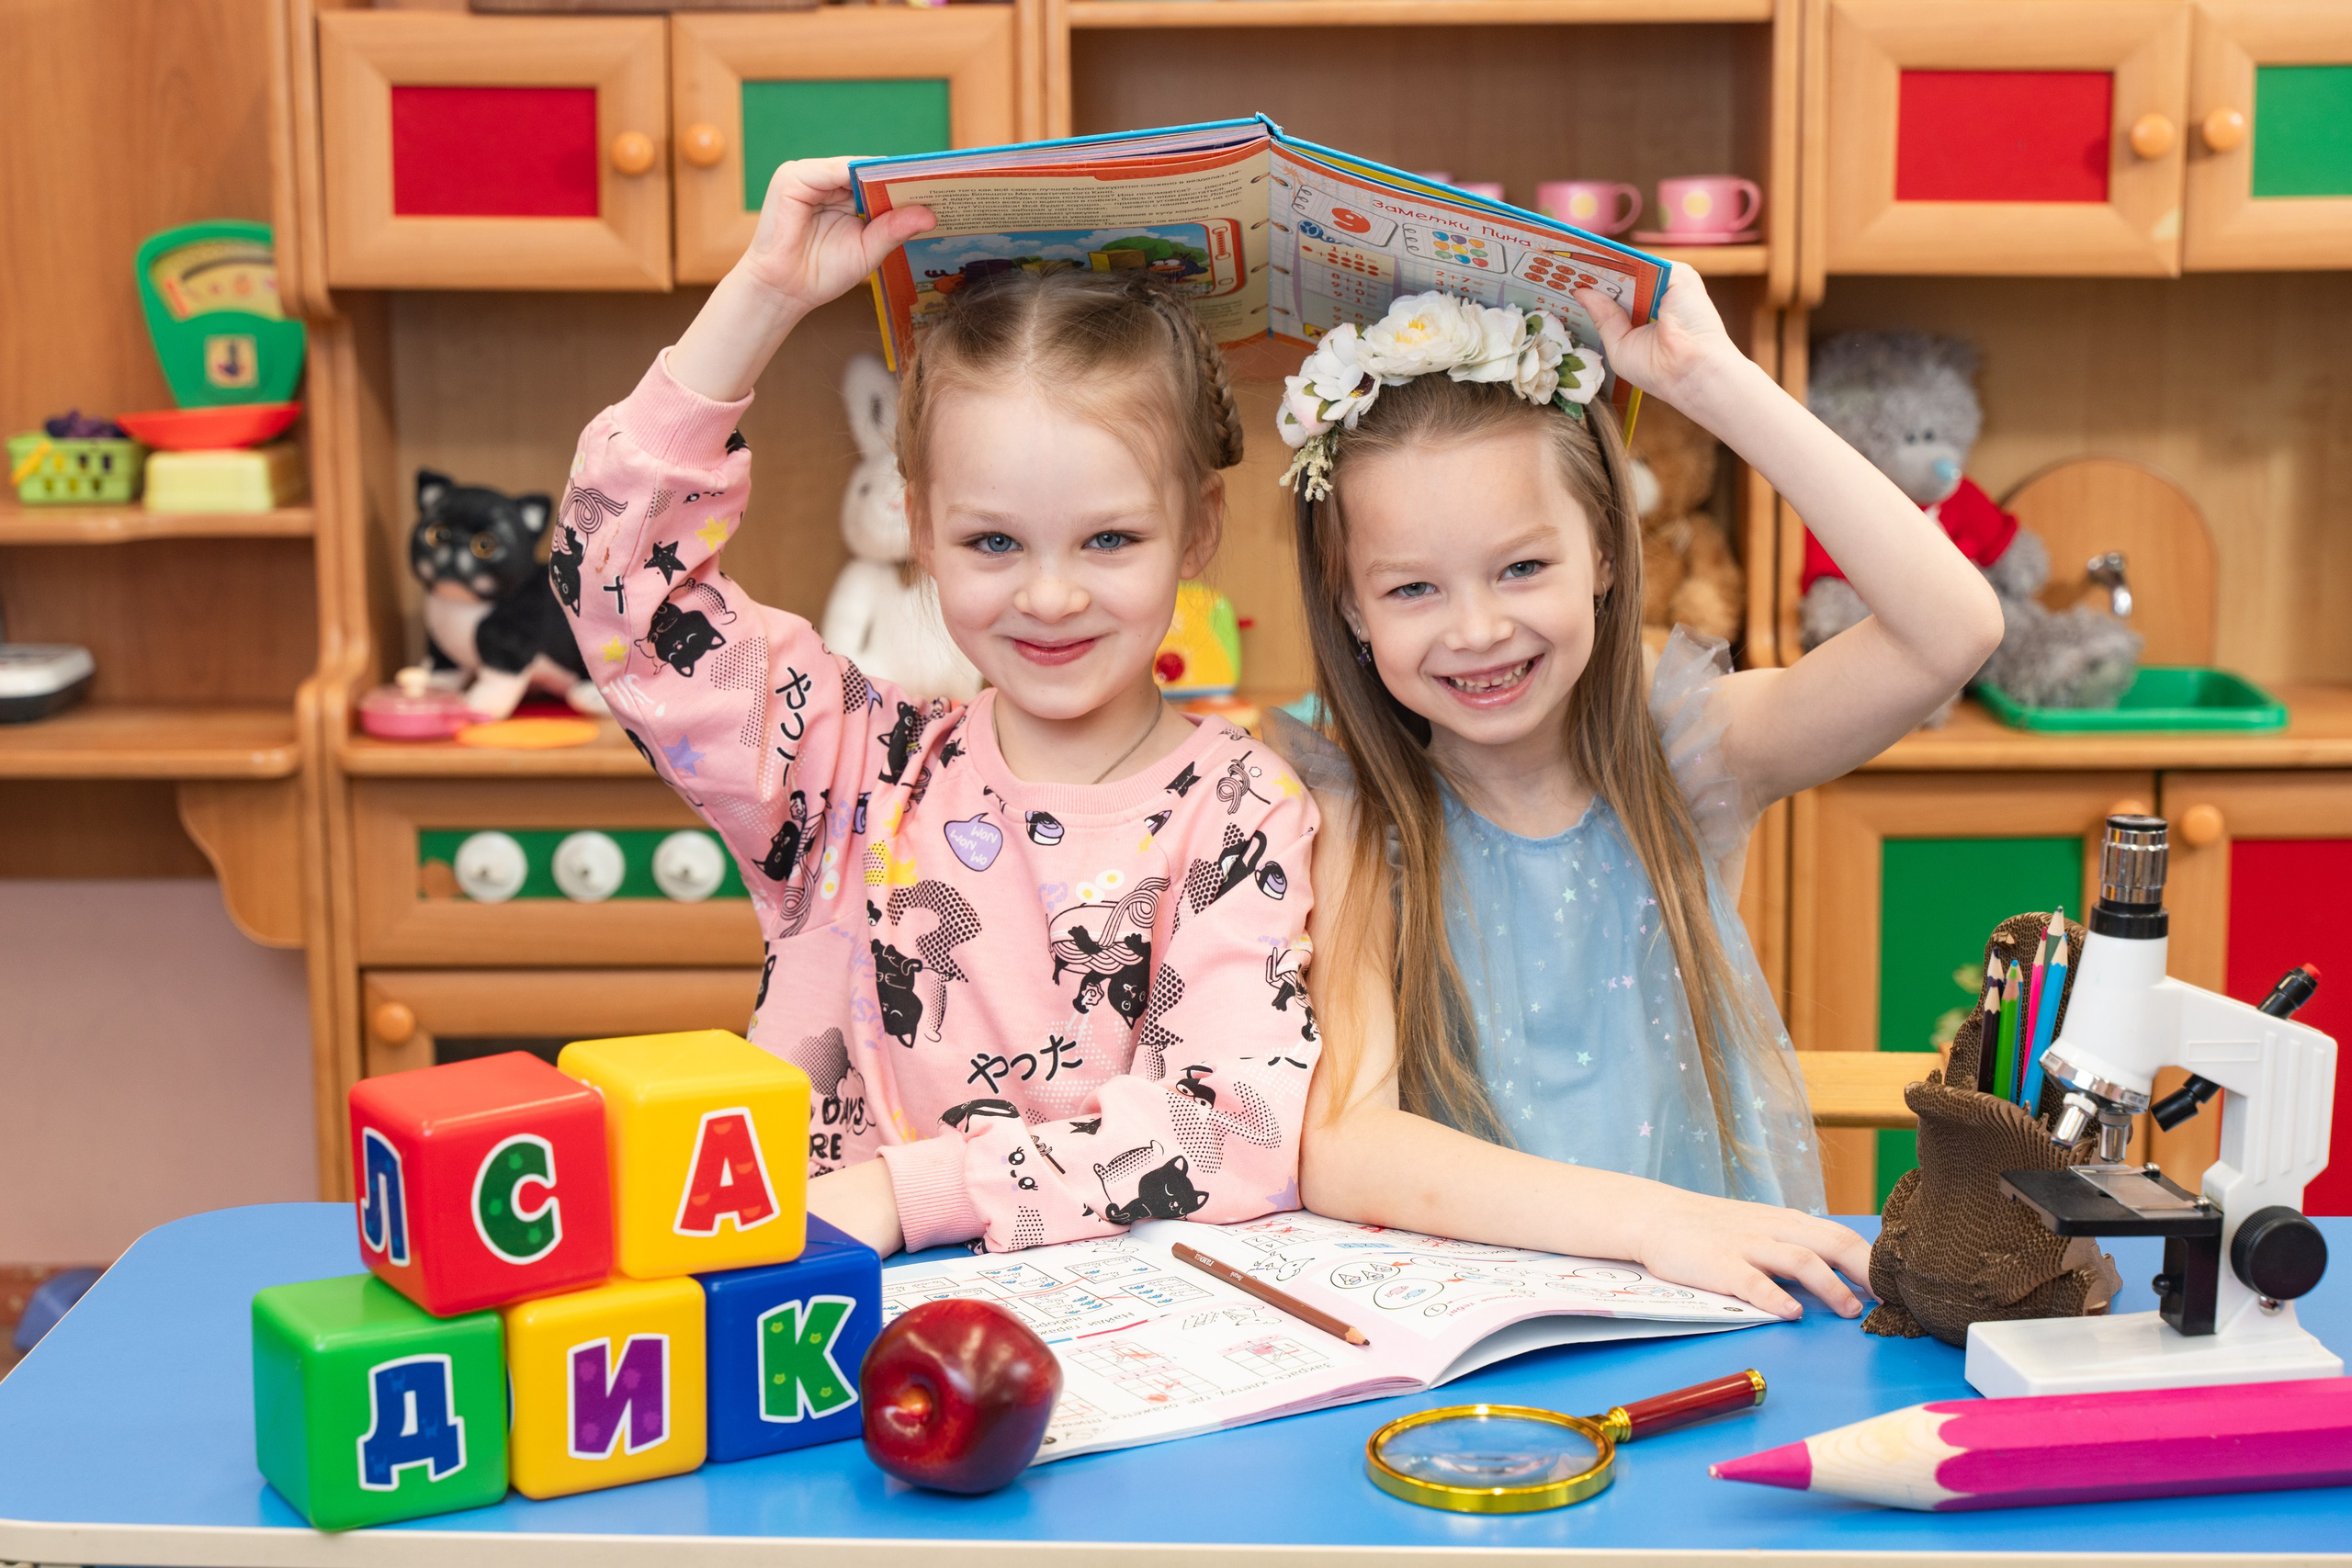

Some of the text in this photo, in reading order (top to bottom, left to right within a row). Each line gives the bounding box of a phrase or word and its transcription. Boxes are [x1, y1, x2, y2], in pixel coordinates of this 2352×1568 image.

[1331, 208, 1371, 233] 9
[1373, 199, 1532, 247] Заметки Пина
[949, 829, 978, 851] NOM
[970, 825, 999, 843] NOM
[970, 851, 988, 865] OM
[967, 1033, 1084, 1095] やった
[809, 1133, 842, 1160] RE
[673, 1106, 780, 1237] А
[361, 1126, 410, 1267] Л
[470, 1133, 563, 1265] С
[1029, 1316, 1082, 1330] наборо
[1087, 1311, 1136, 1327] Найди
[757, 1295, 859, 1424] К
[1274, 1361, 1333, 1382] Закрась
[566, 1333, 670, 1460] И
[1186, 1394, 1212, 1405] где
[1215, 1380, 1269, 1397] клетку,
[356, 1353, 467, 1492] Д
[1110, 1404, 1180, 1421] окажется
